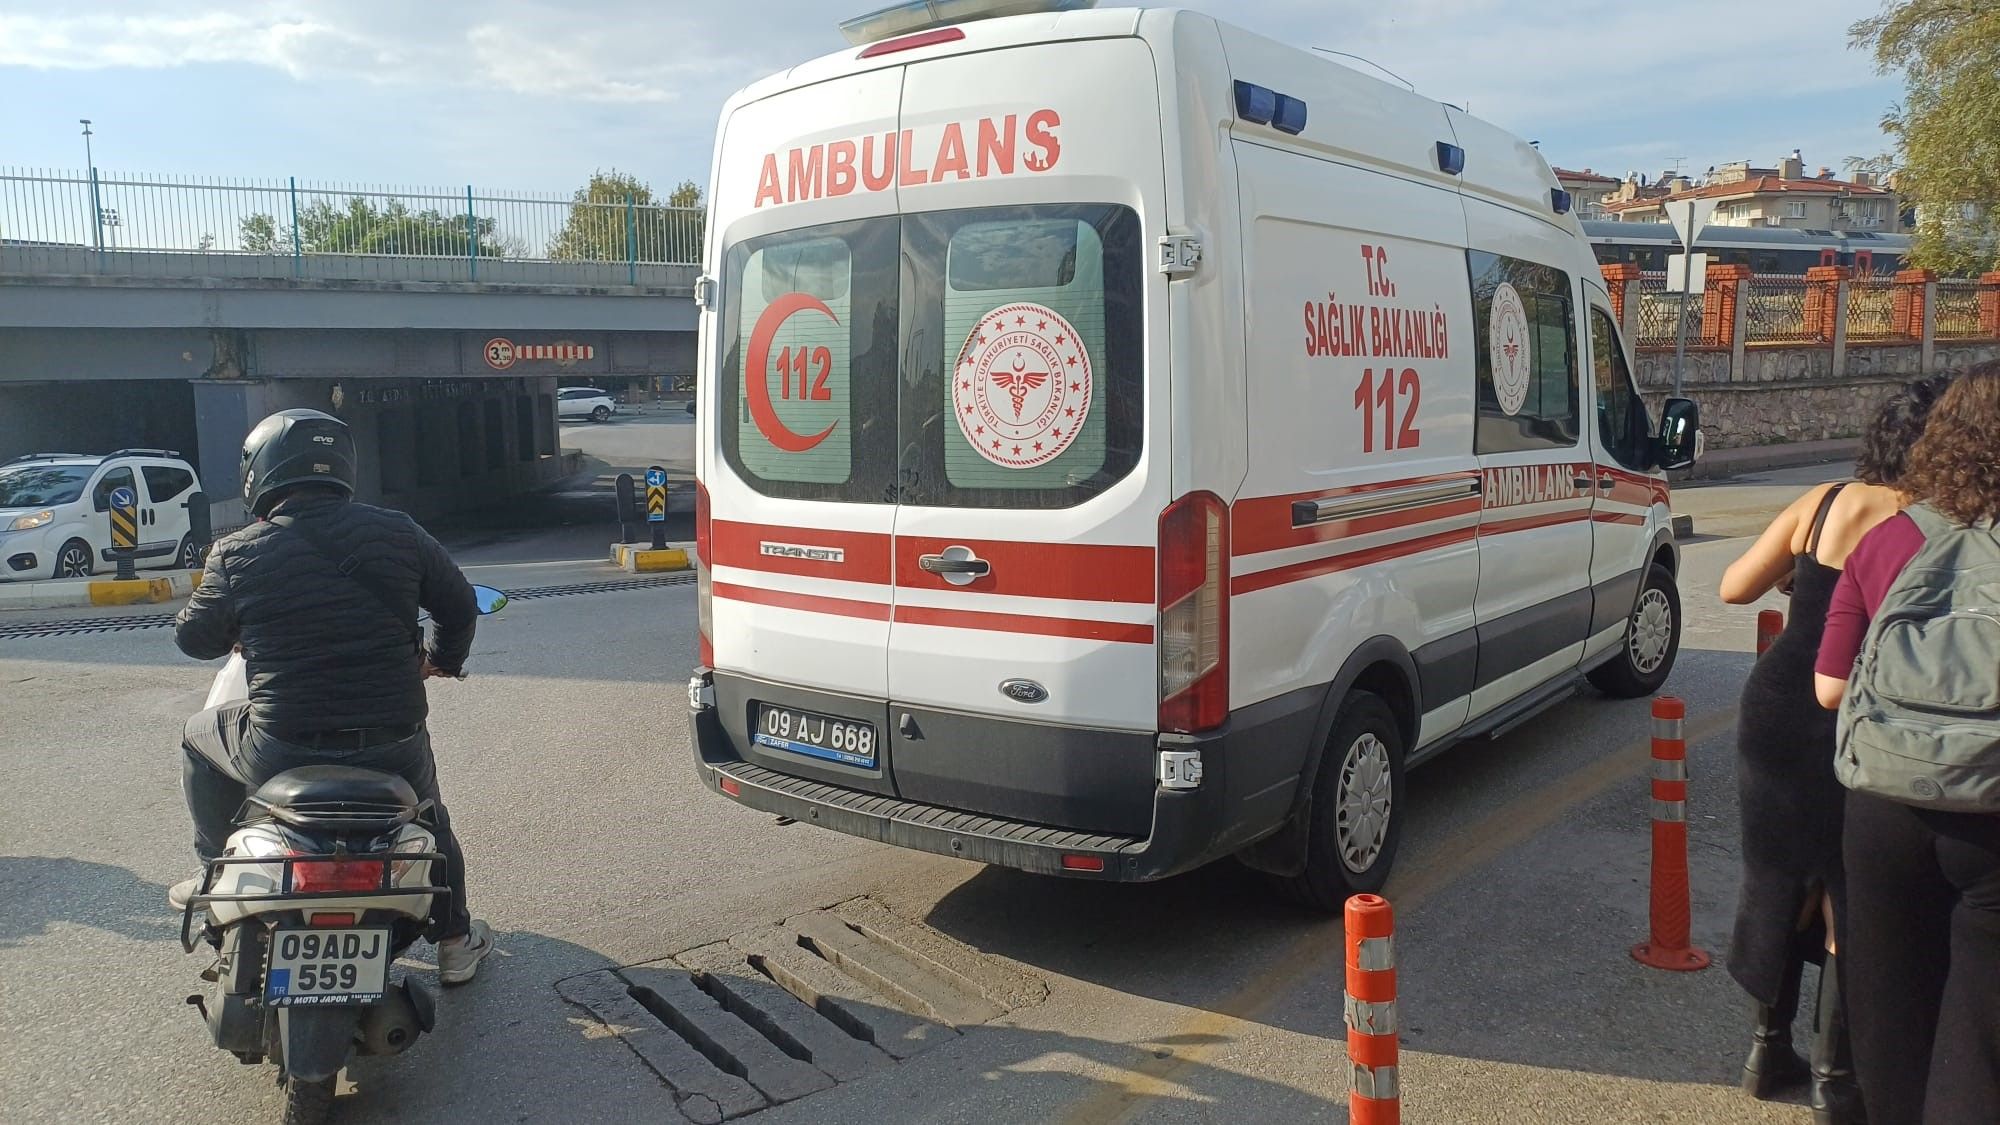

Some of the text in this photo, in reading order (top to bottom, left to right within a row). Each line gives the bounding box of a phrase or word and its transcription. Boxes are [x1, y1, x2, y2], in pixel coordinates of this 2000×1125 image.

[754, 108, 1061, 208] AMBULANS
[1361, 244, 1396, 298] T.C.
[1304, 292, 1367, 357] SAĞLIK
[1371, 301, 1449, 359] BAKANLIĞI
[1031, 338, 1059, 370] SAĞLIK
[776, 345, 832, 401] 112
[1354, 367, 1421, 454] 112
[1484, 466, 1574, 508] AMBULANS
[761, 544, 843, 561] TRANSIT
[1010, 684, 1036, 699] Ford
[768, 708, 791, 737] 09
[796, 715, 825, 744] AJ
[831, 721, 872, 754] 668
[281, 934, 380, 961] 09ADJ
[273, 986, 285, 996] TR
[298, 963, 357, 991] 559
[293, 996, 318, 1004] MOTO
[319, 995, 348, 1004] JAPON
